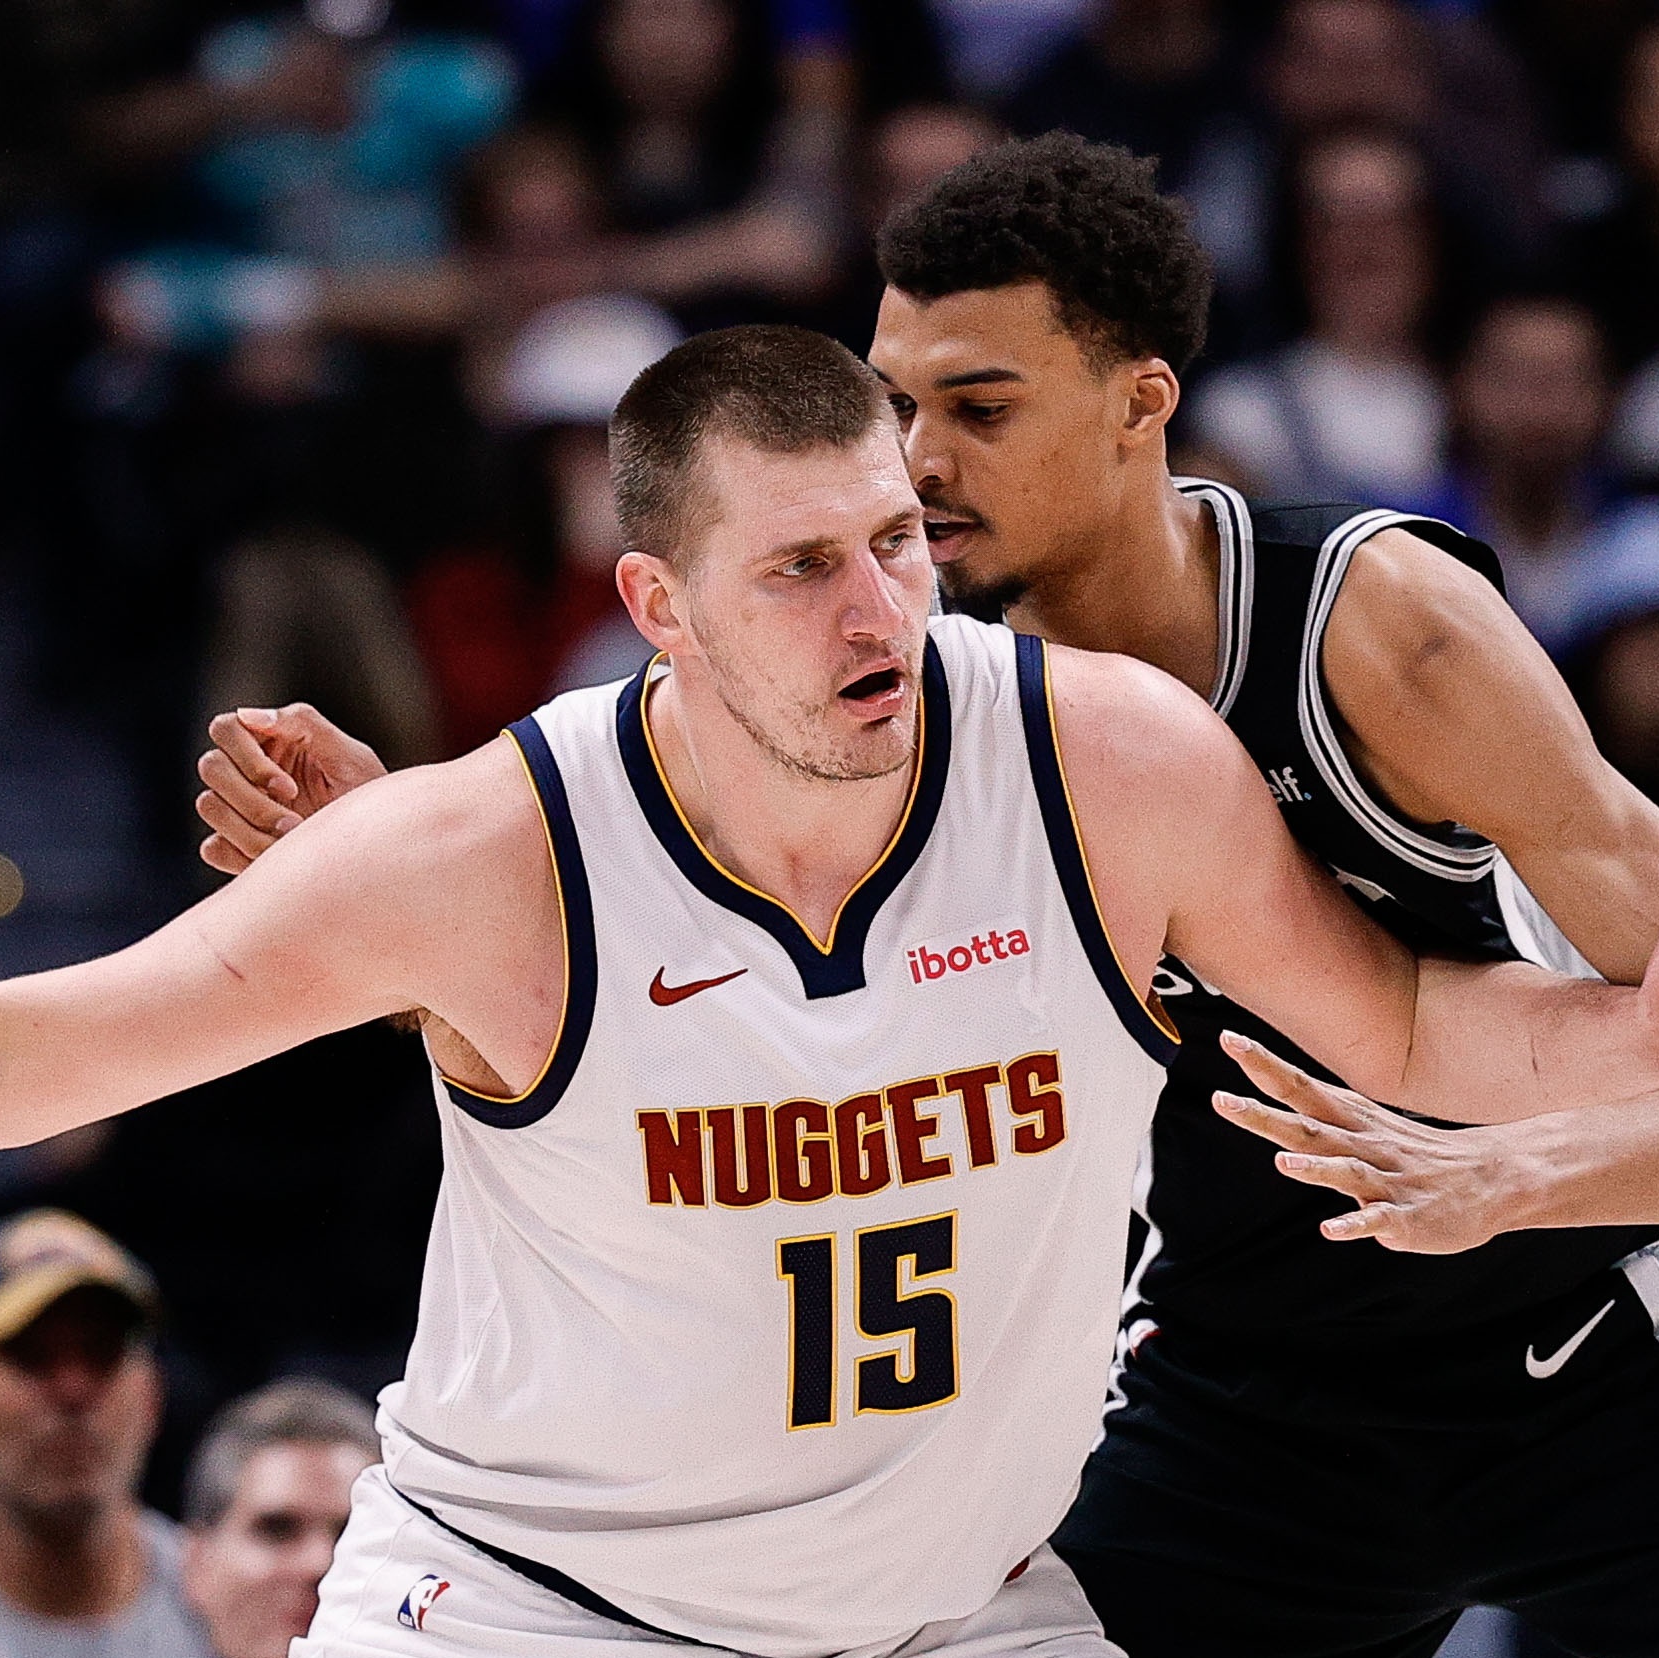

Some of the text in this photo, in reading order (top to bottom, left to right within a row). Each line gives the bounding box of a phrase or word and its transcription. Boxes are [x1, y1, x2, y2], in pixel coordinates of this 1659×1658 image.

[907, 929, 1030, 984] ibotta
[635, 1050, 1066, 1209] NUGGETS
[775, 1209, 960, 1432] 15
